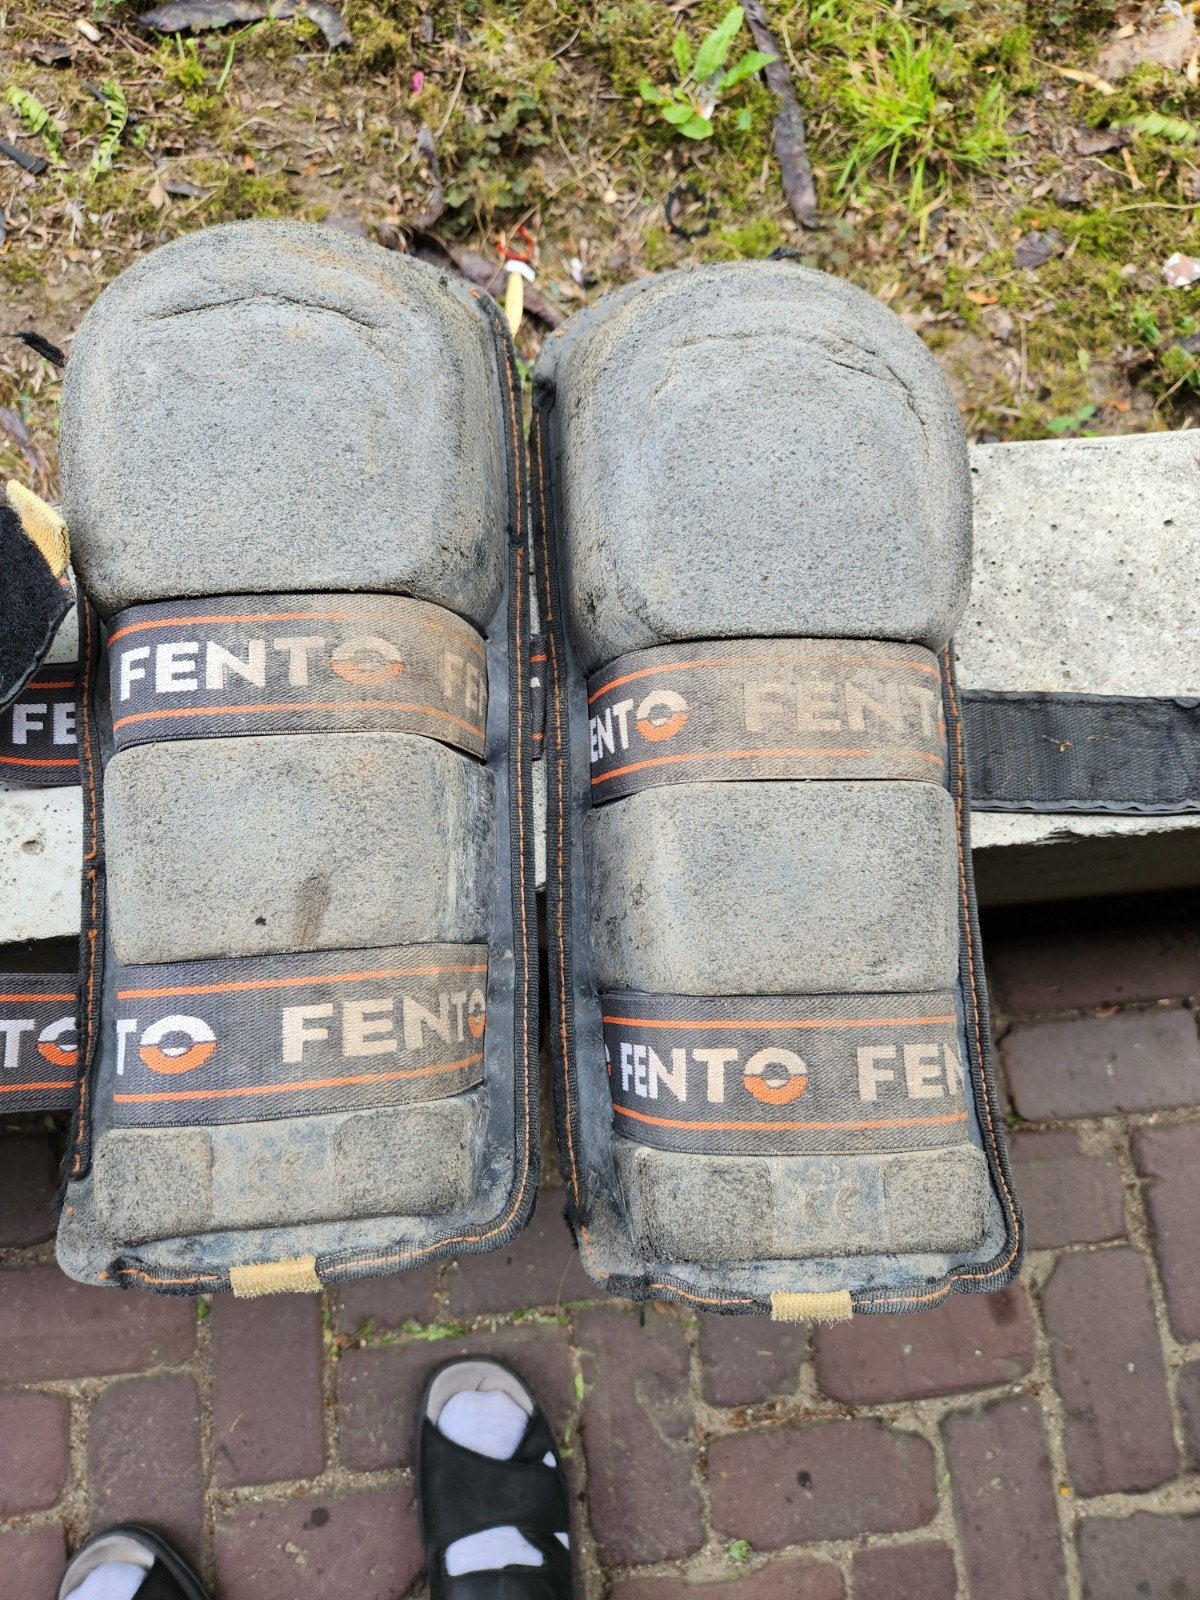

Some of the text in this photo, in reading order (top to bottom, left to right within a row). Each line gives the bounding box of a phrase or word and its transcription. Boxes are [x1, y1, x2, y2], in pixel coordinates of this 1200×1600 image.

[120, 634, 404, 701] FENTO
[12, 702, 78, 745] FE
[743, 679, 945, 742] FENT
[282, 988, 486, 1063] FENTO
[620, 1042, 809, 1105] FENTO
